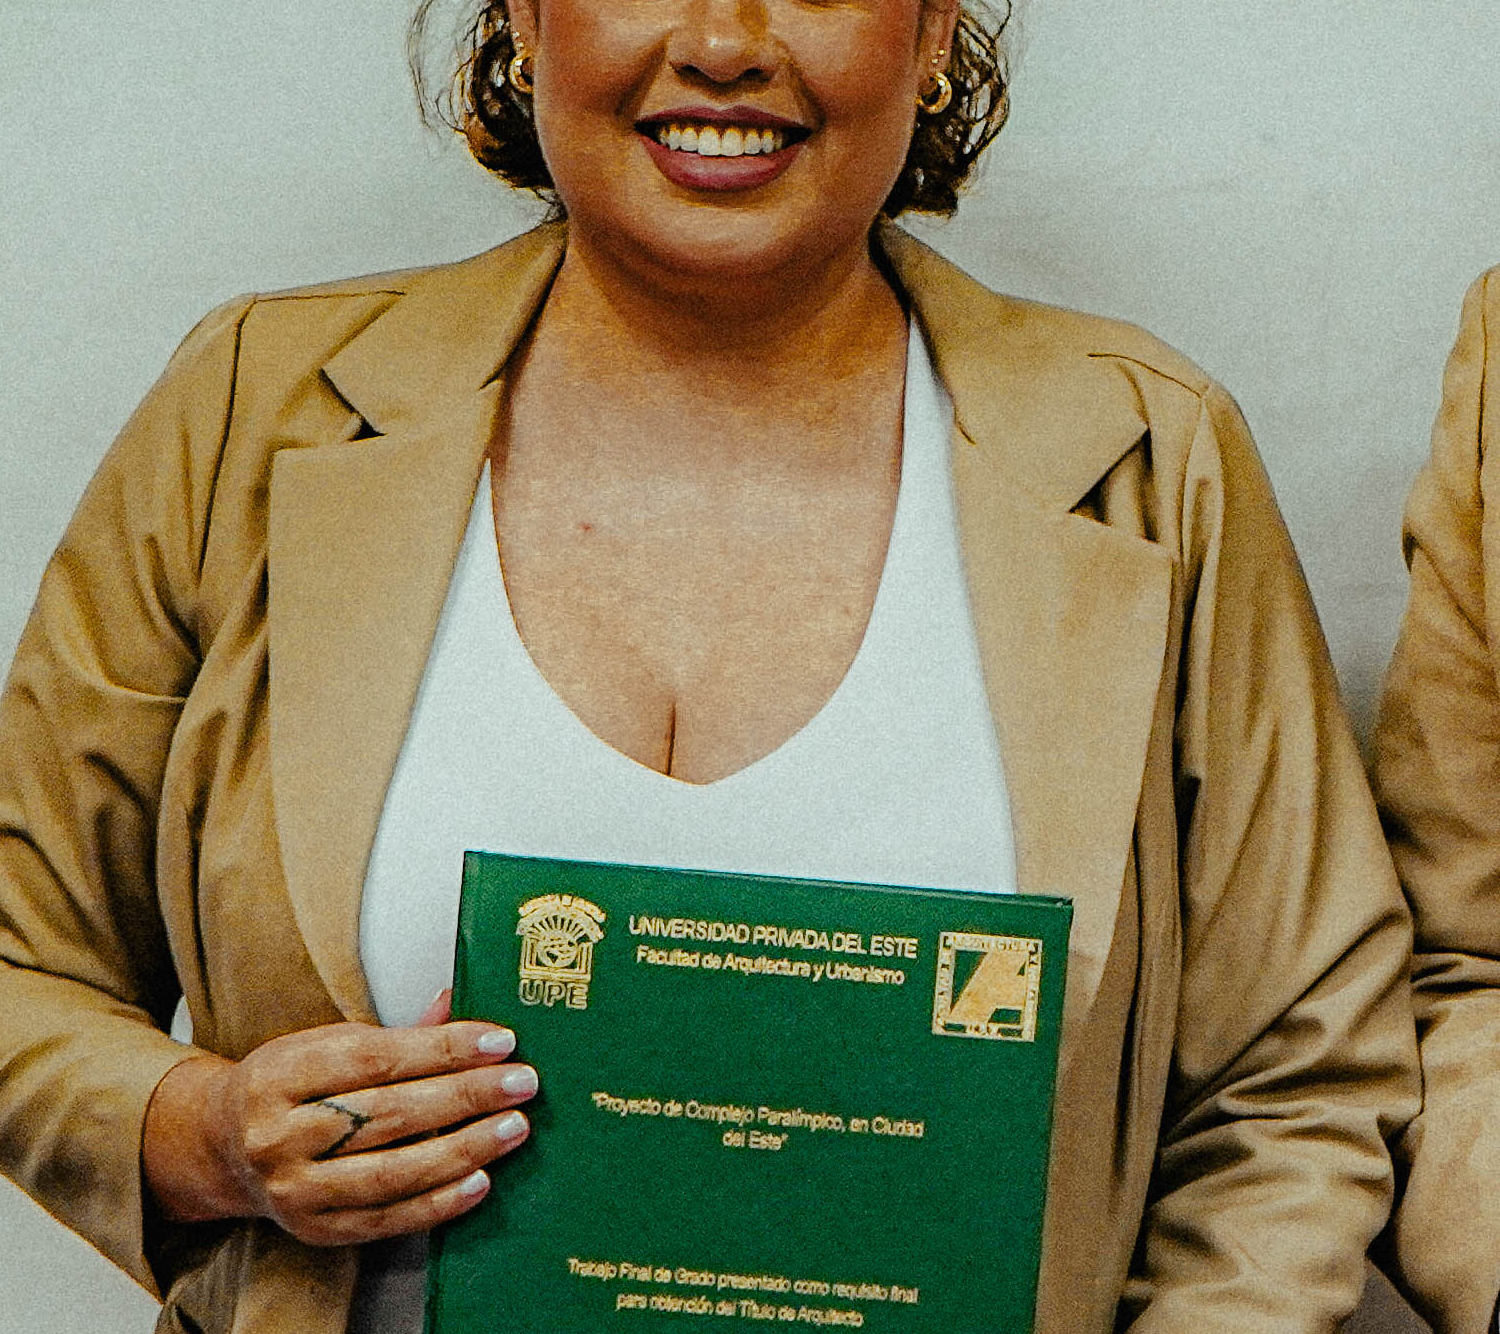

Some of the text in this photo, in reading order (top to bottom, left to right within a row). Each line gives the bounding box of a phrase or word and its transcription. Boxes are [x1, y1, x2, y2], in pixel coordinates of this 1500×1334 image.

[629, 916, 919, 959] UNIVERSIDAD PRIVADA DEL ESTE
[636, 945, 905, 984] Facultad de Arquitectura y Urbanismo
[518, 978, 589, 1010] UPE
[662, 1099, 684, 1117] de
[685, 1100, 755, 1126] Complejo
[849, 1118, 869, 1132] en
[871, 1116, 925, 1137] Ciudad
[722, 1130, 746, 1148] del
[568, 1258, 919, 1304] Trabajo Final de Grado presentado como requisito final
[777, 1305, 797, 1322] de
